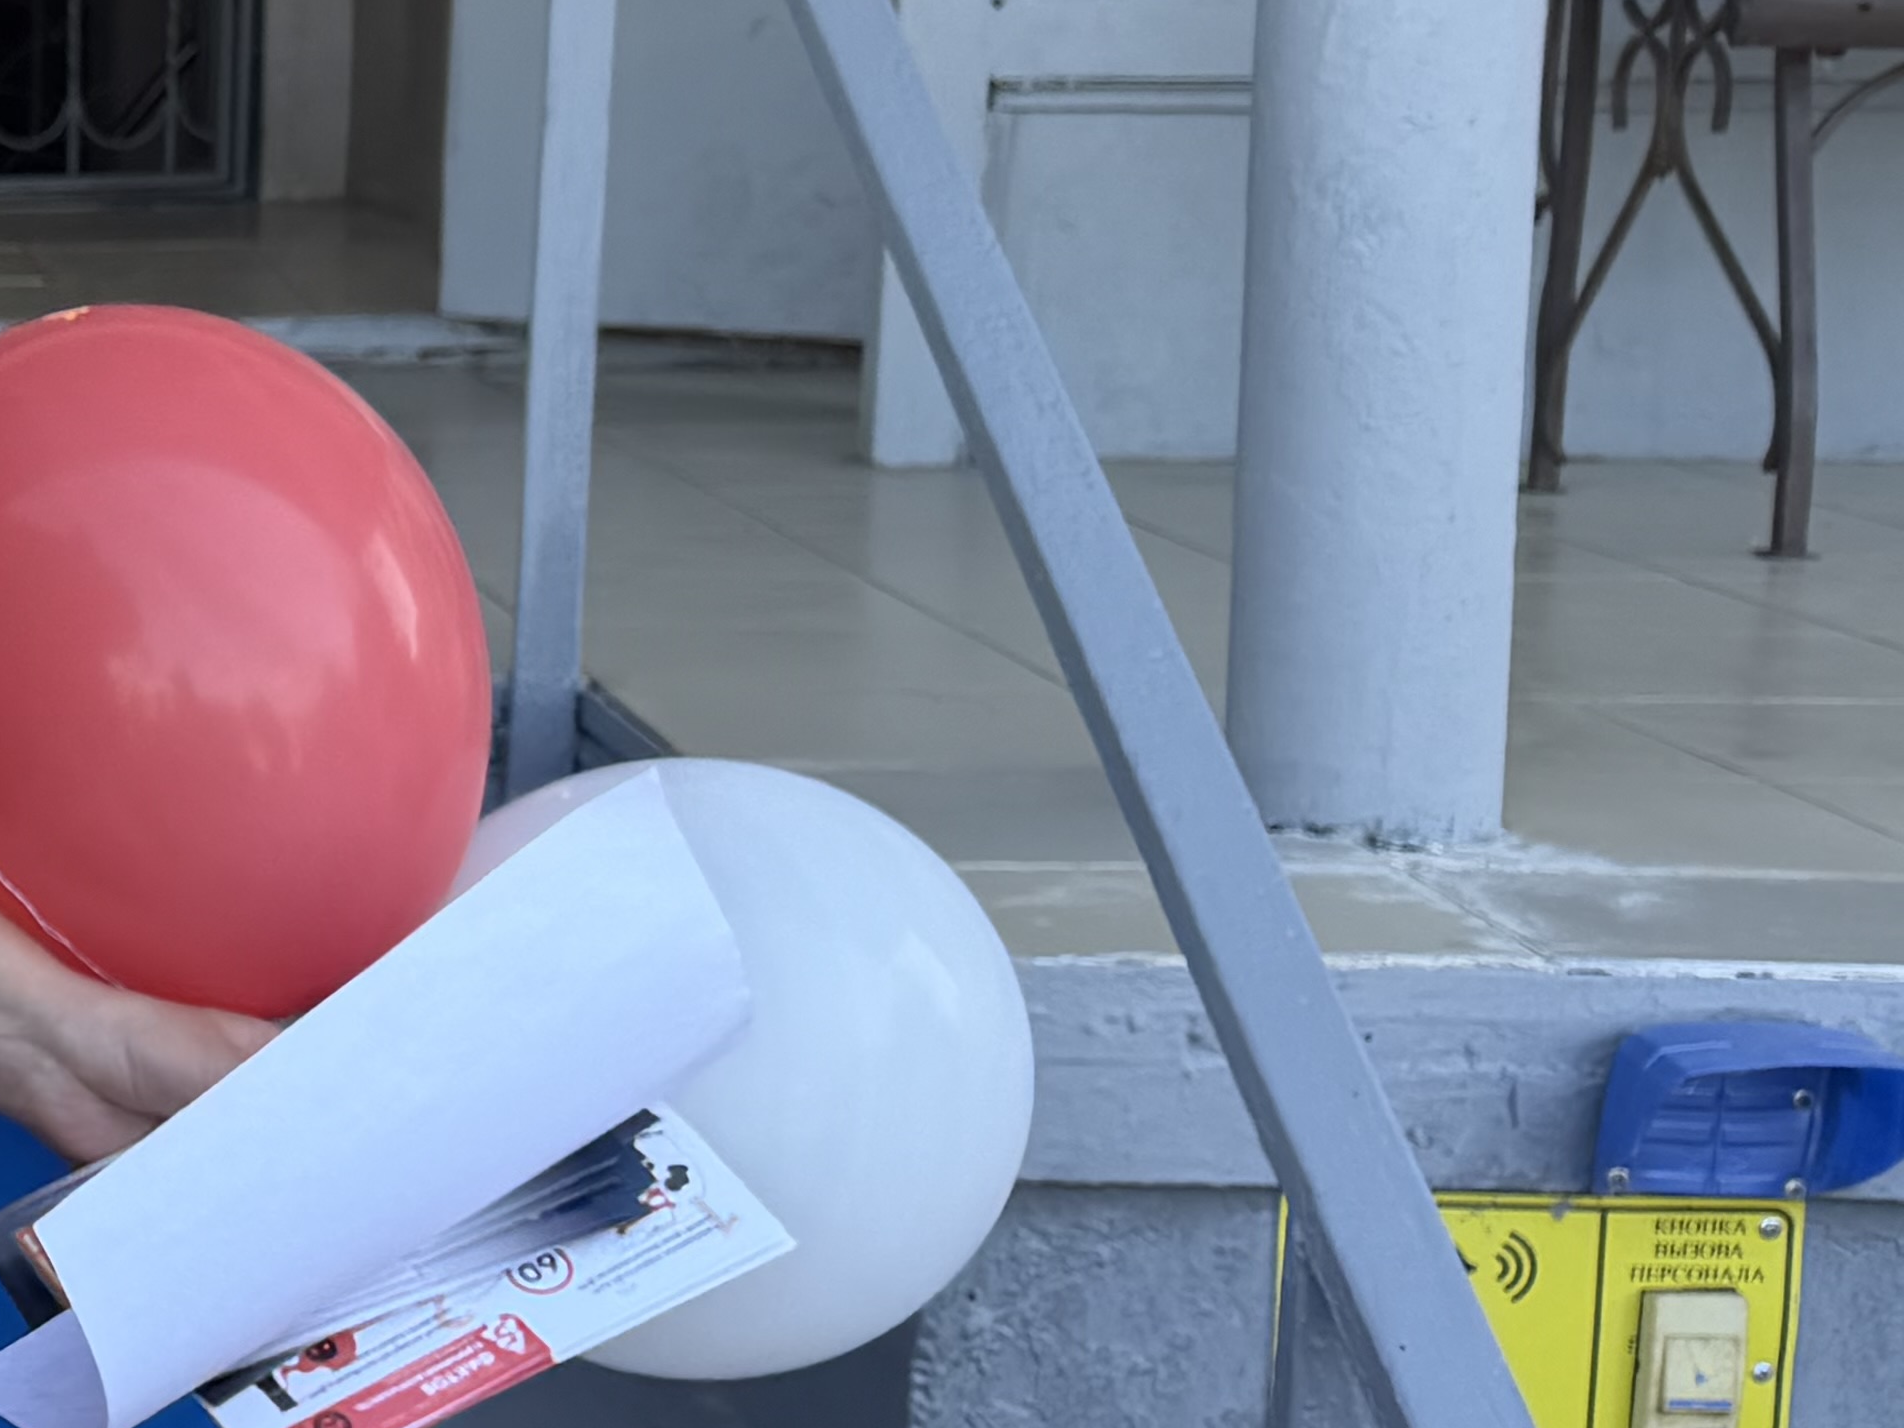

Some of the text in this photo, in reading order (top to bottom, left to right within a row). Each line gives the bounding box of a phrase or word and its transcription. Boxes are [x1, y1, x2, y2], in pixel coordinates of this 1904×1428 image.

[1654, 1217, 1747, 1236] КНОПКА
[1653, 1241, 1744, 1259] ВЫЗОВА
[518, 1251, 558, 1284] 60
[1630, 1265, 1766, 1284] ПЕРСОНАЛА
